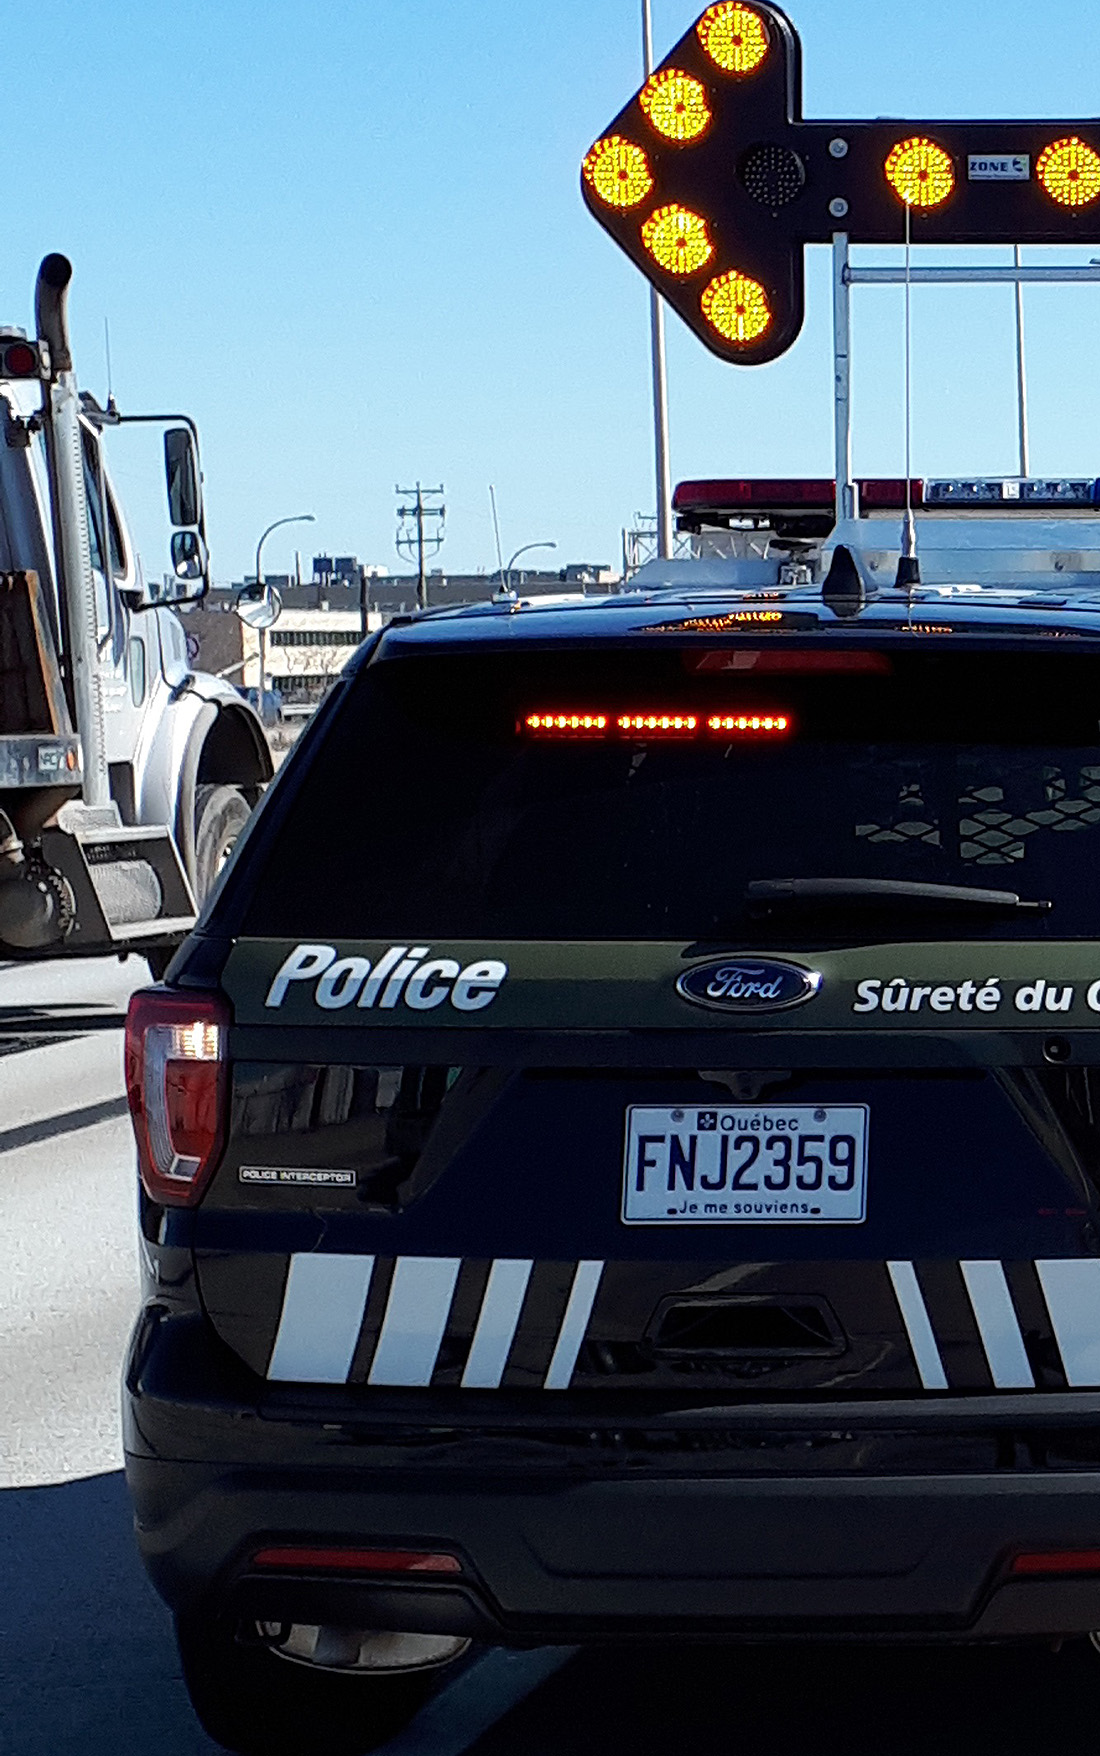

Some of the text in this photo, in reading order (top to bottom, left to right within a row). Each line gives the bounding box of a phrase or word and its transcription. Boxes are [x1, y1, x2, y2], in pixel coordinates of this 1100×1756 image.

[970, 161, 1009, 172] ZONE
[264, 943, 508, 1012] Police
[706, 966, 784, 998] Ford
[852, 978, 1001, 1013] Sûreté
[1014, 979, 1073, 1012] du
[720, 1112, 799, 1132] Québec
[242, 1169, 352, 1183] POLICE INTERCEPTOR
[635, 1134, 857, 1192] FNJ2359
[679, 1200, 809, 1214] Je me souviens
